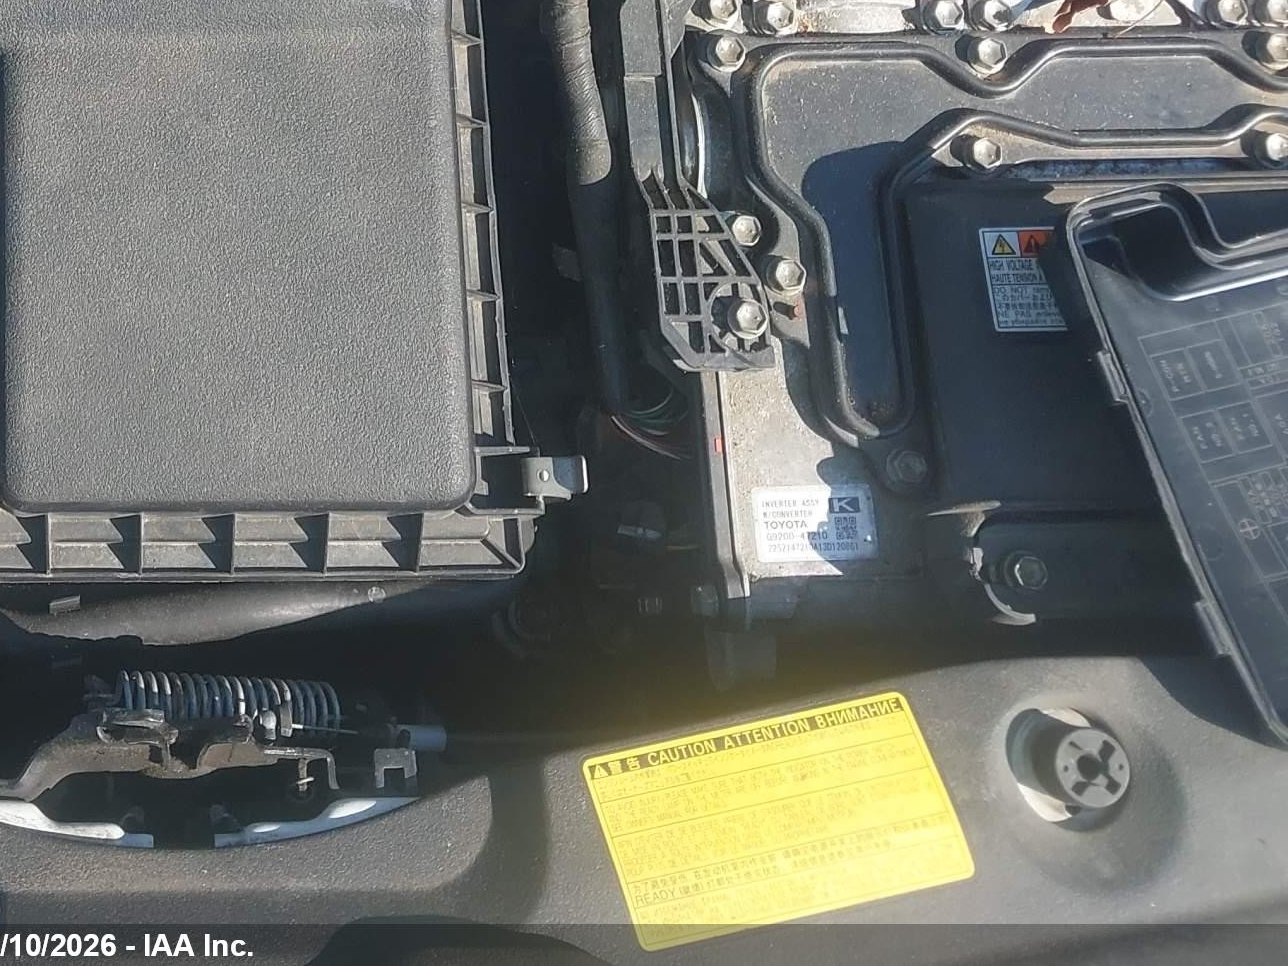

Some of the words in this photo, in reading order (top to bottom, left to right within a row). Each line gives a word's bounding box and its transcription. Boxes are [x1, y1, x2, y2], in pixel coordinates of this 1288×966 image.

[761, 500, 797, 508] INVERTER
[763, 521, 808, 529] TOYOTA
[647, 737, 716, 767] CAUTION
[723, 718, 810, 750] ATTENTION
[815, 698, 902, 730] ВНИМАНИЕ
